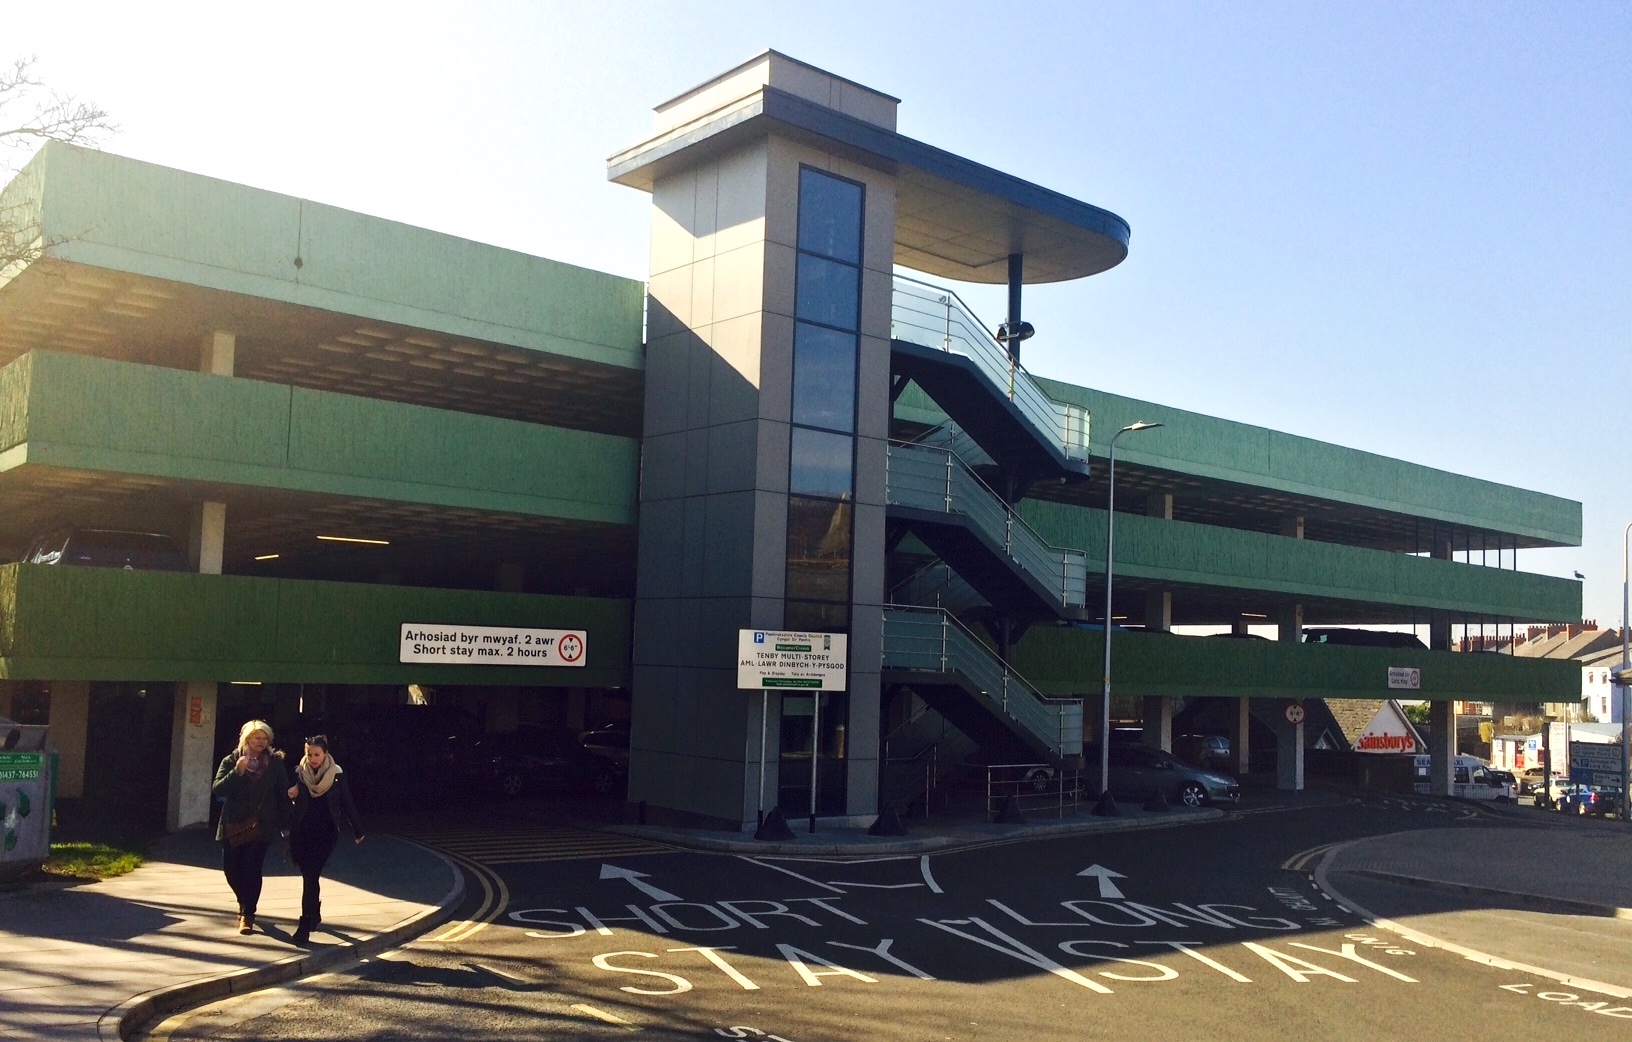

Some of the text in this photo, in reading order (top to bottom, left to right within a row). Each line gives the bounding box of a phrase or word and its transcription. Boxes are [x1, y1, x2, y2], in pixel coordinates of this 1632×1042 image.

[405, 630, 555, 646] Arhosiad byr mwyaf. 2 awr
[413, 644, 548, 658] Short stay max. 2 hours
[509, 897, 868, 938] SHORT
[986, 898, 1301, 930] LONG
[592, 939, 936, 994] STAY
[1058, 940, 1420, 983] STAY
